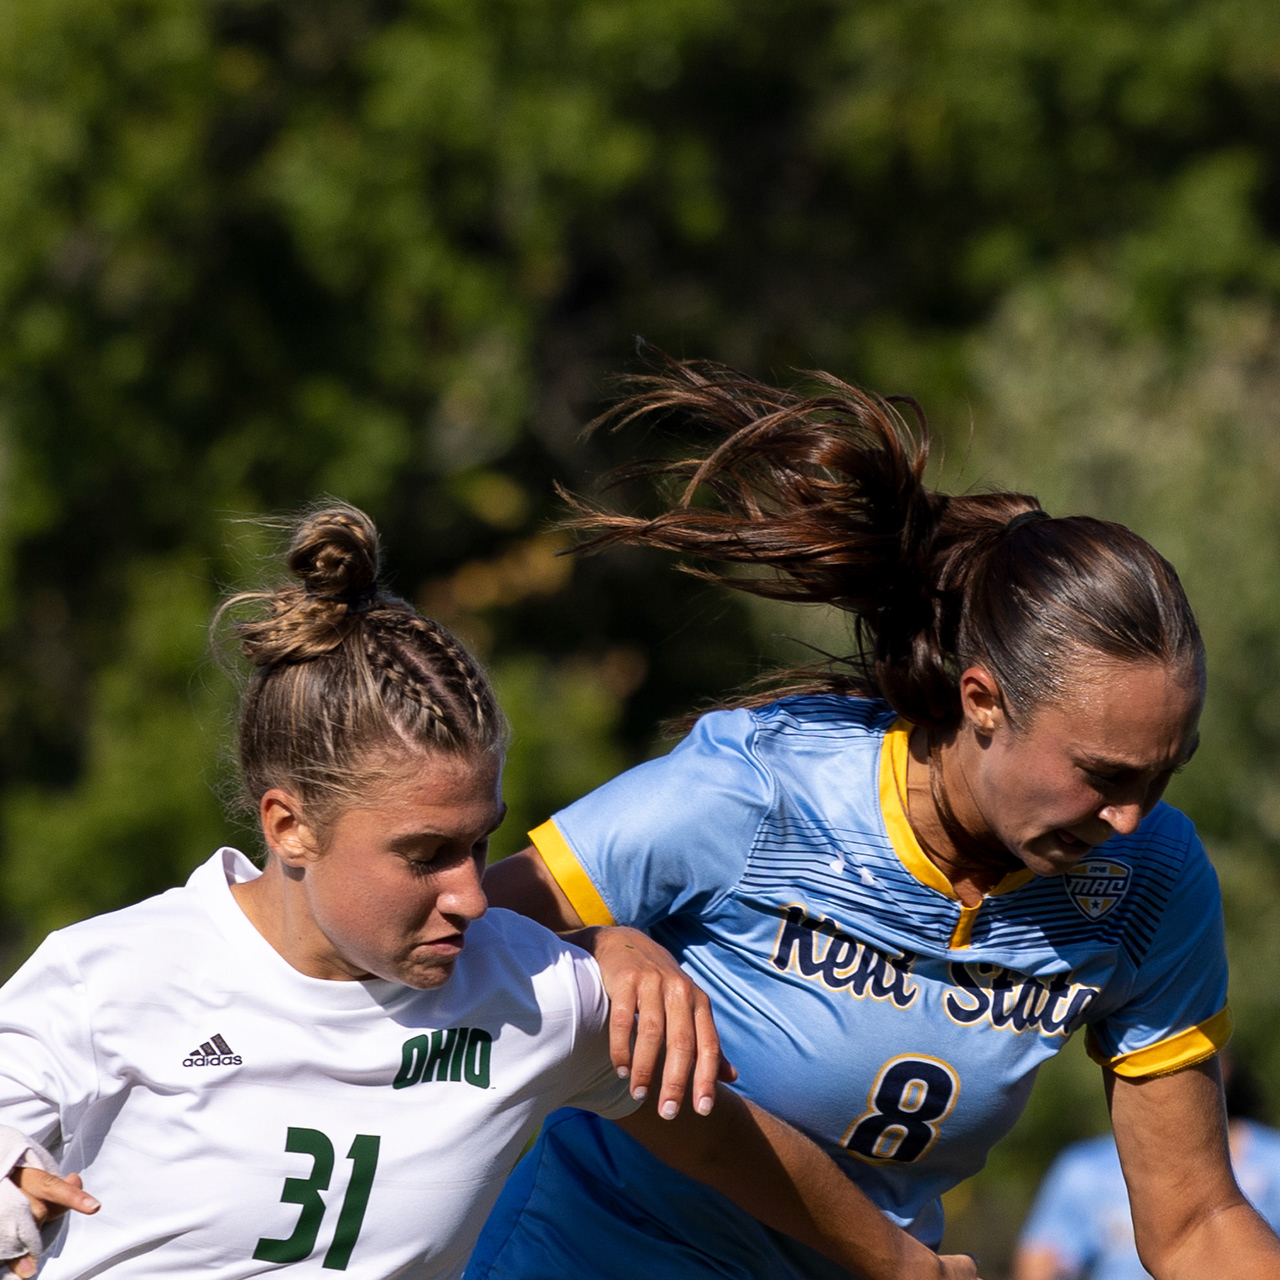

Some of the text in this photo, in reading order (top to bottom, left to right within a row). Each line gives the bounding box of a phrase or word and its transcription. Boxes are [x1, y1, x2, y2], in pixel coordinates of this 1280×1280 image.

[1069, 879, 1126, 894] MAC
[768, 902, 920, 1010] Kent
[182, 1053, 243, 1068] adidas
[392, 1027, 492, 1090] OHIO
[839, 1052, 961, 1167] 8
[252, 1126, 381, 1271] 31
